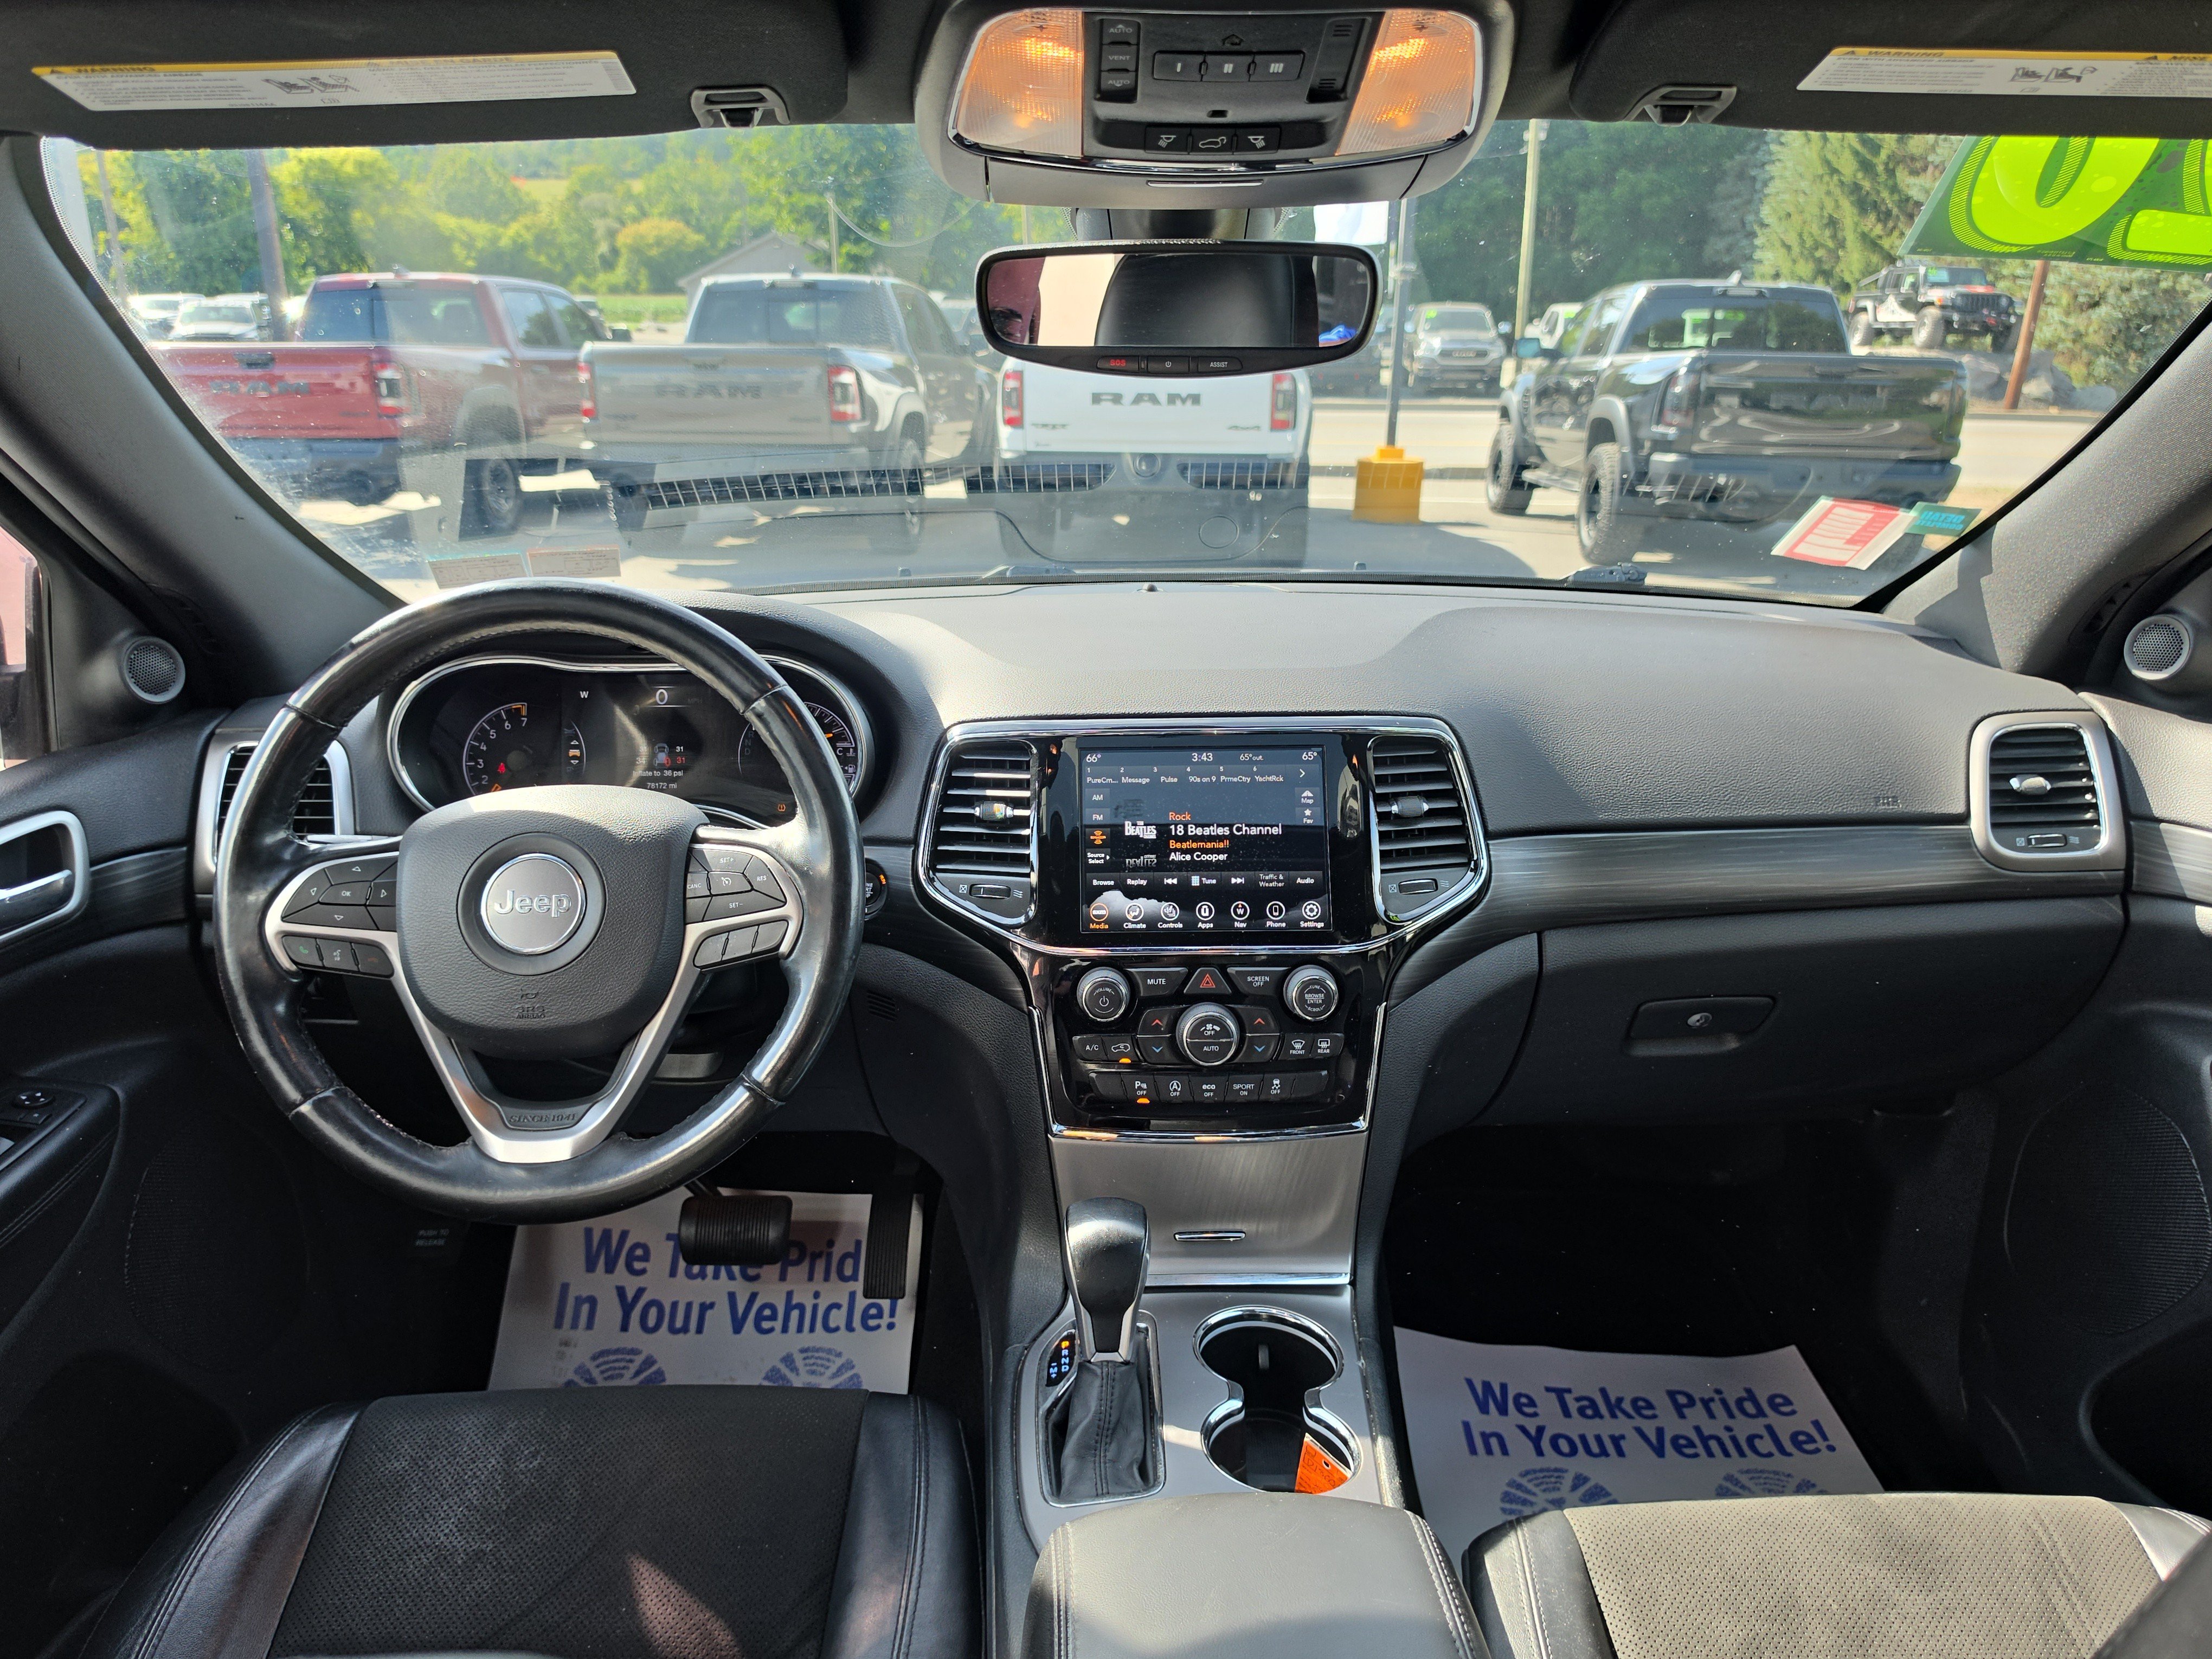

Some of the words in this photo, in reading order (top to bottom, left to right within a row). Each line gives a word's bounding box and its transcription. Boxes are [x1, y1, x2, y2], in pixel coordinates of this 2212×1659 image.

[1091, 392, 1201, 407] RAM
[504, 721, 511, 730] 6
[520, 717, 528, 727] 7
[490, 730, 496, 739] 5
[480, 742, 487, 751] 4
[1192, 753, 1213, 762] 3:43
[477, 759, 484, 769] 3
[481, 775, 488, 785] 2
[1122, 776, 1150, 785] Message
[1169, 812, 1191, 821] Rock
[1124, 821, 1157, 838] BEATLES
[1169, 824, 1184, 836] 18
[1188, 823, 1230, 835] Beatles
[1233, 823, 1282, 835] Channel
[1169, 840, 1229, 849] Beatlemania!!
[1169, 852, 1191, 861] Alice
[1193, 852, 1228, 862] Cooper
[494, 889, 572, 918] Jeep
[583, 1226, 651, 1278] We
[777, 1239, 863, 1284] Prid
[552, 1282, 599, 1331] In
[615, 1284, 716, 1335] Your
[726, 1289, 899, 1335] Vehicle!
[1061, 1341, 1070, 1349] P
[1061, 1356, 1069, 1365] N
[1463, 1377, 1539, 1420] We
[1544, 1385, 1659, 1422] Take
[1665, 1386, 1796, 1422] Pride
[1462, 1419, 1510, 1457] In
[1515, 1423, 1626, 1459] Your
[1634, 1419, 1837, 1460] Vehicle!
